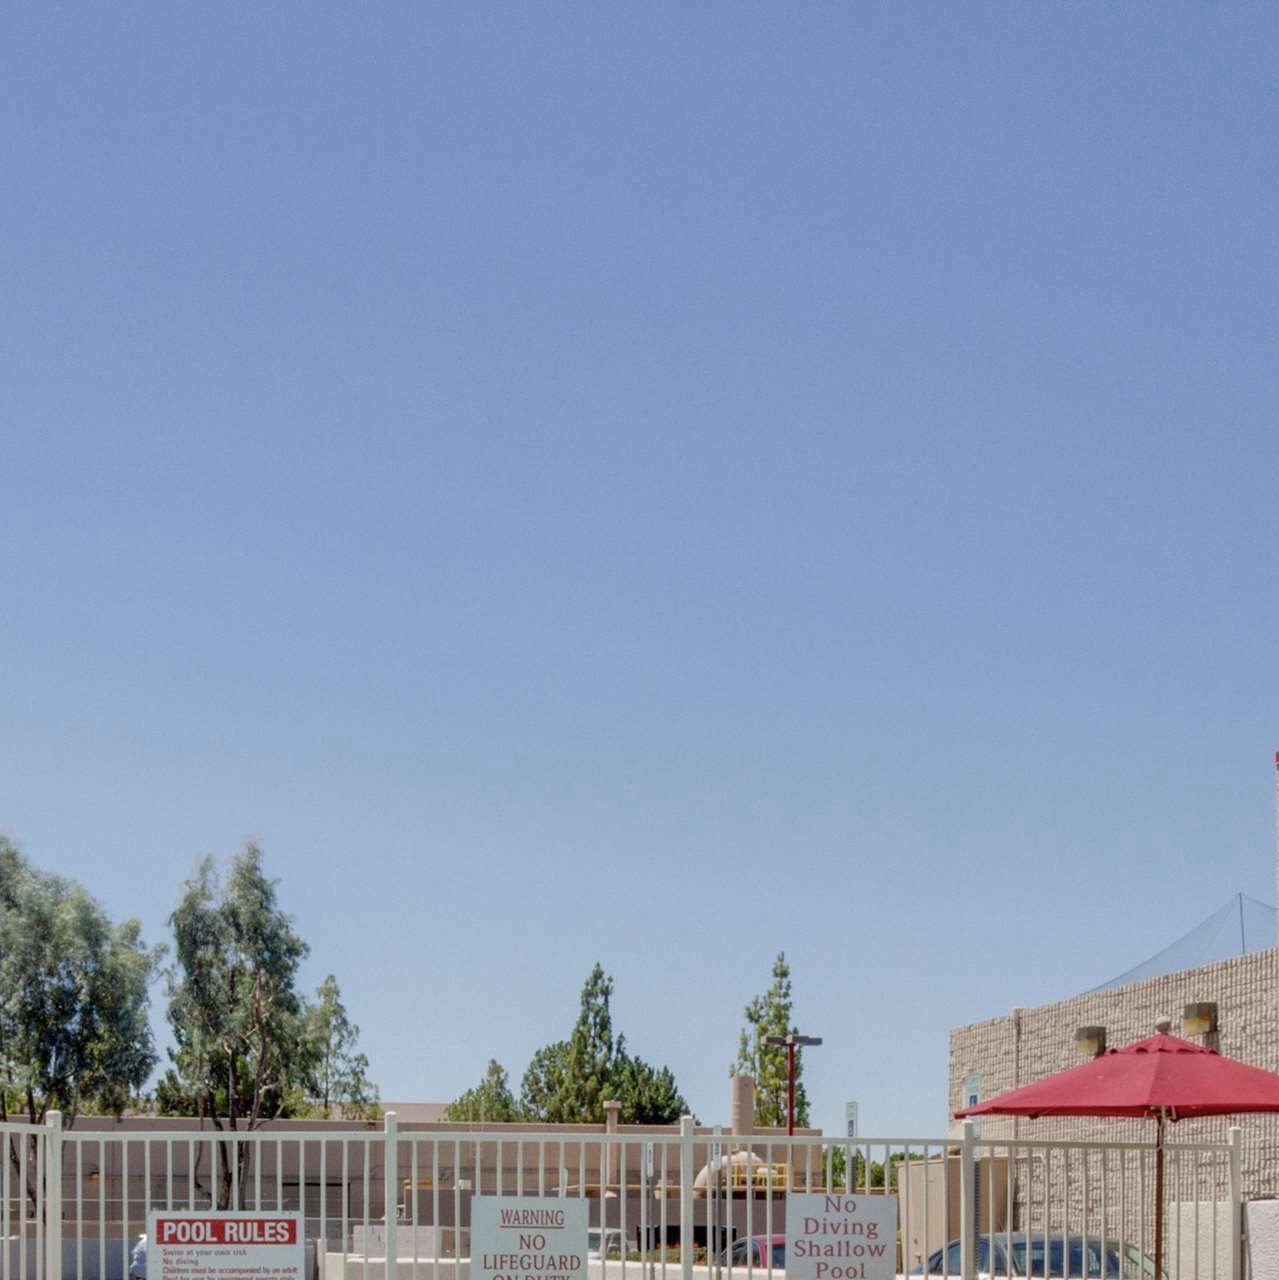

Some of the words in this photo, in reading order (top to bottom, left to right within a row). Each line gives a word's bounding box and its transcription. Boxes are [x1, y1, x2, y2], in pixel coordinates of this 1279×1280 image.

[824, 1195, 857, 1213] No
[500, 1209, 565, 1226] WARNING
[163, 1221, 218, 1242] POOL
[224, 1221, 290, 1242] RULES
[803, 1217, 878, 1240] Diving
[518, 1234, 546, 1251] NO
[794, 1239, 887, 1258] Shallow
[195, 1249, 213, 1257] your
[162, 1266, 189, 1274] Children
[175, 1258, 199, 1266] diving
[483, 1254, 581, 1271] LIFEGUARD
[815, 1261, 865, 1280] Pool
